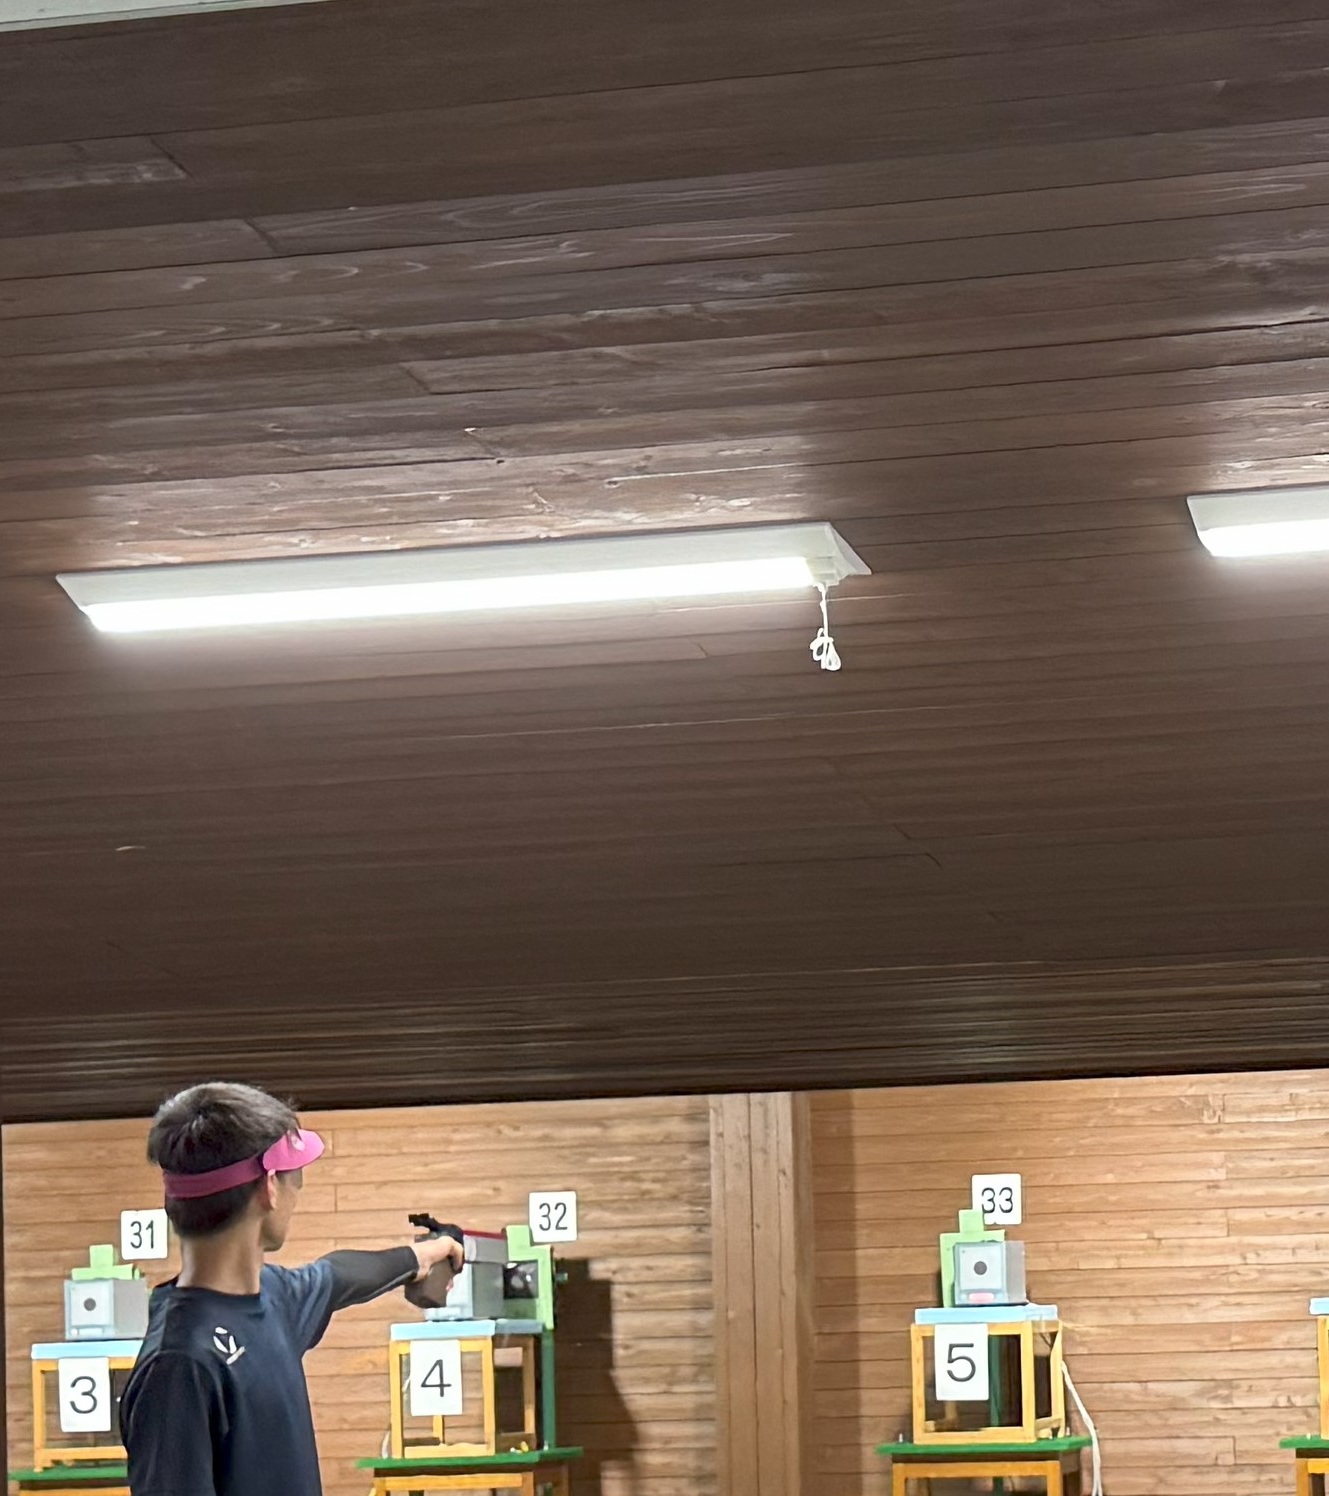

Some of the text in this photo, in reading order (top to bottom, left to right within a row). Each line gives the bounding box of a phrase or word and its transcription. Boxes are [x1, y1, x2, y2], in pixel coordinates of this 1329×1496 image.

[539, 1202, 568, 1231] 32
[981, 1186, 1014, 1214] 33
[130, 1220, 154, 1249] 31
[420, 1359, 452, 1398] 4
[947, 1343, 976, 1383] 5
[70, 1375, 98, 1414] 3
